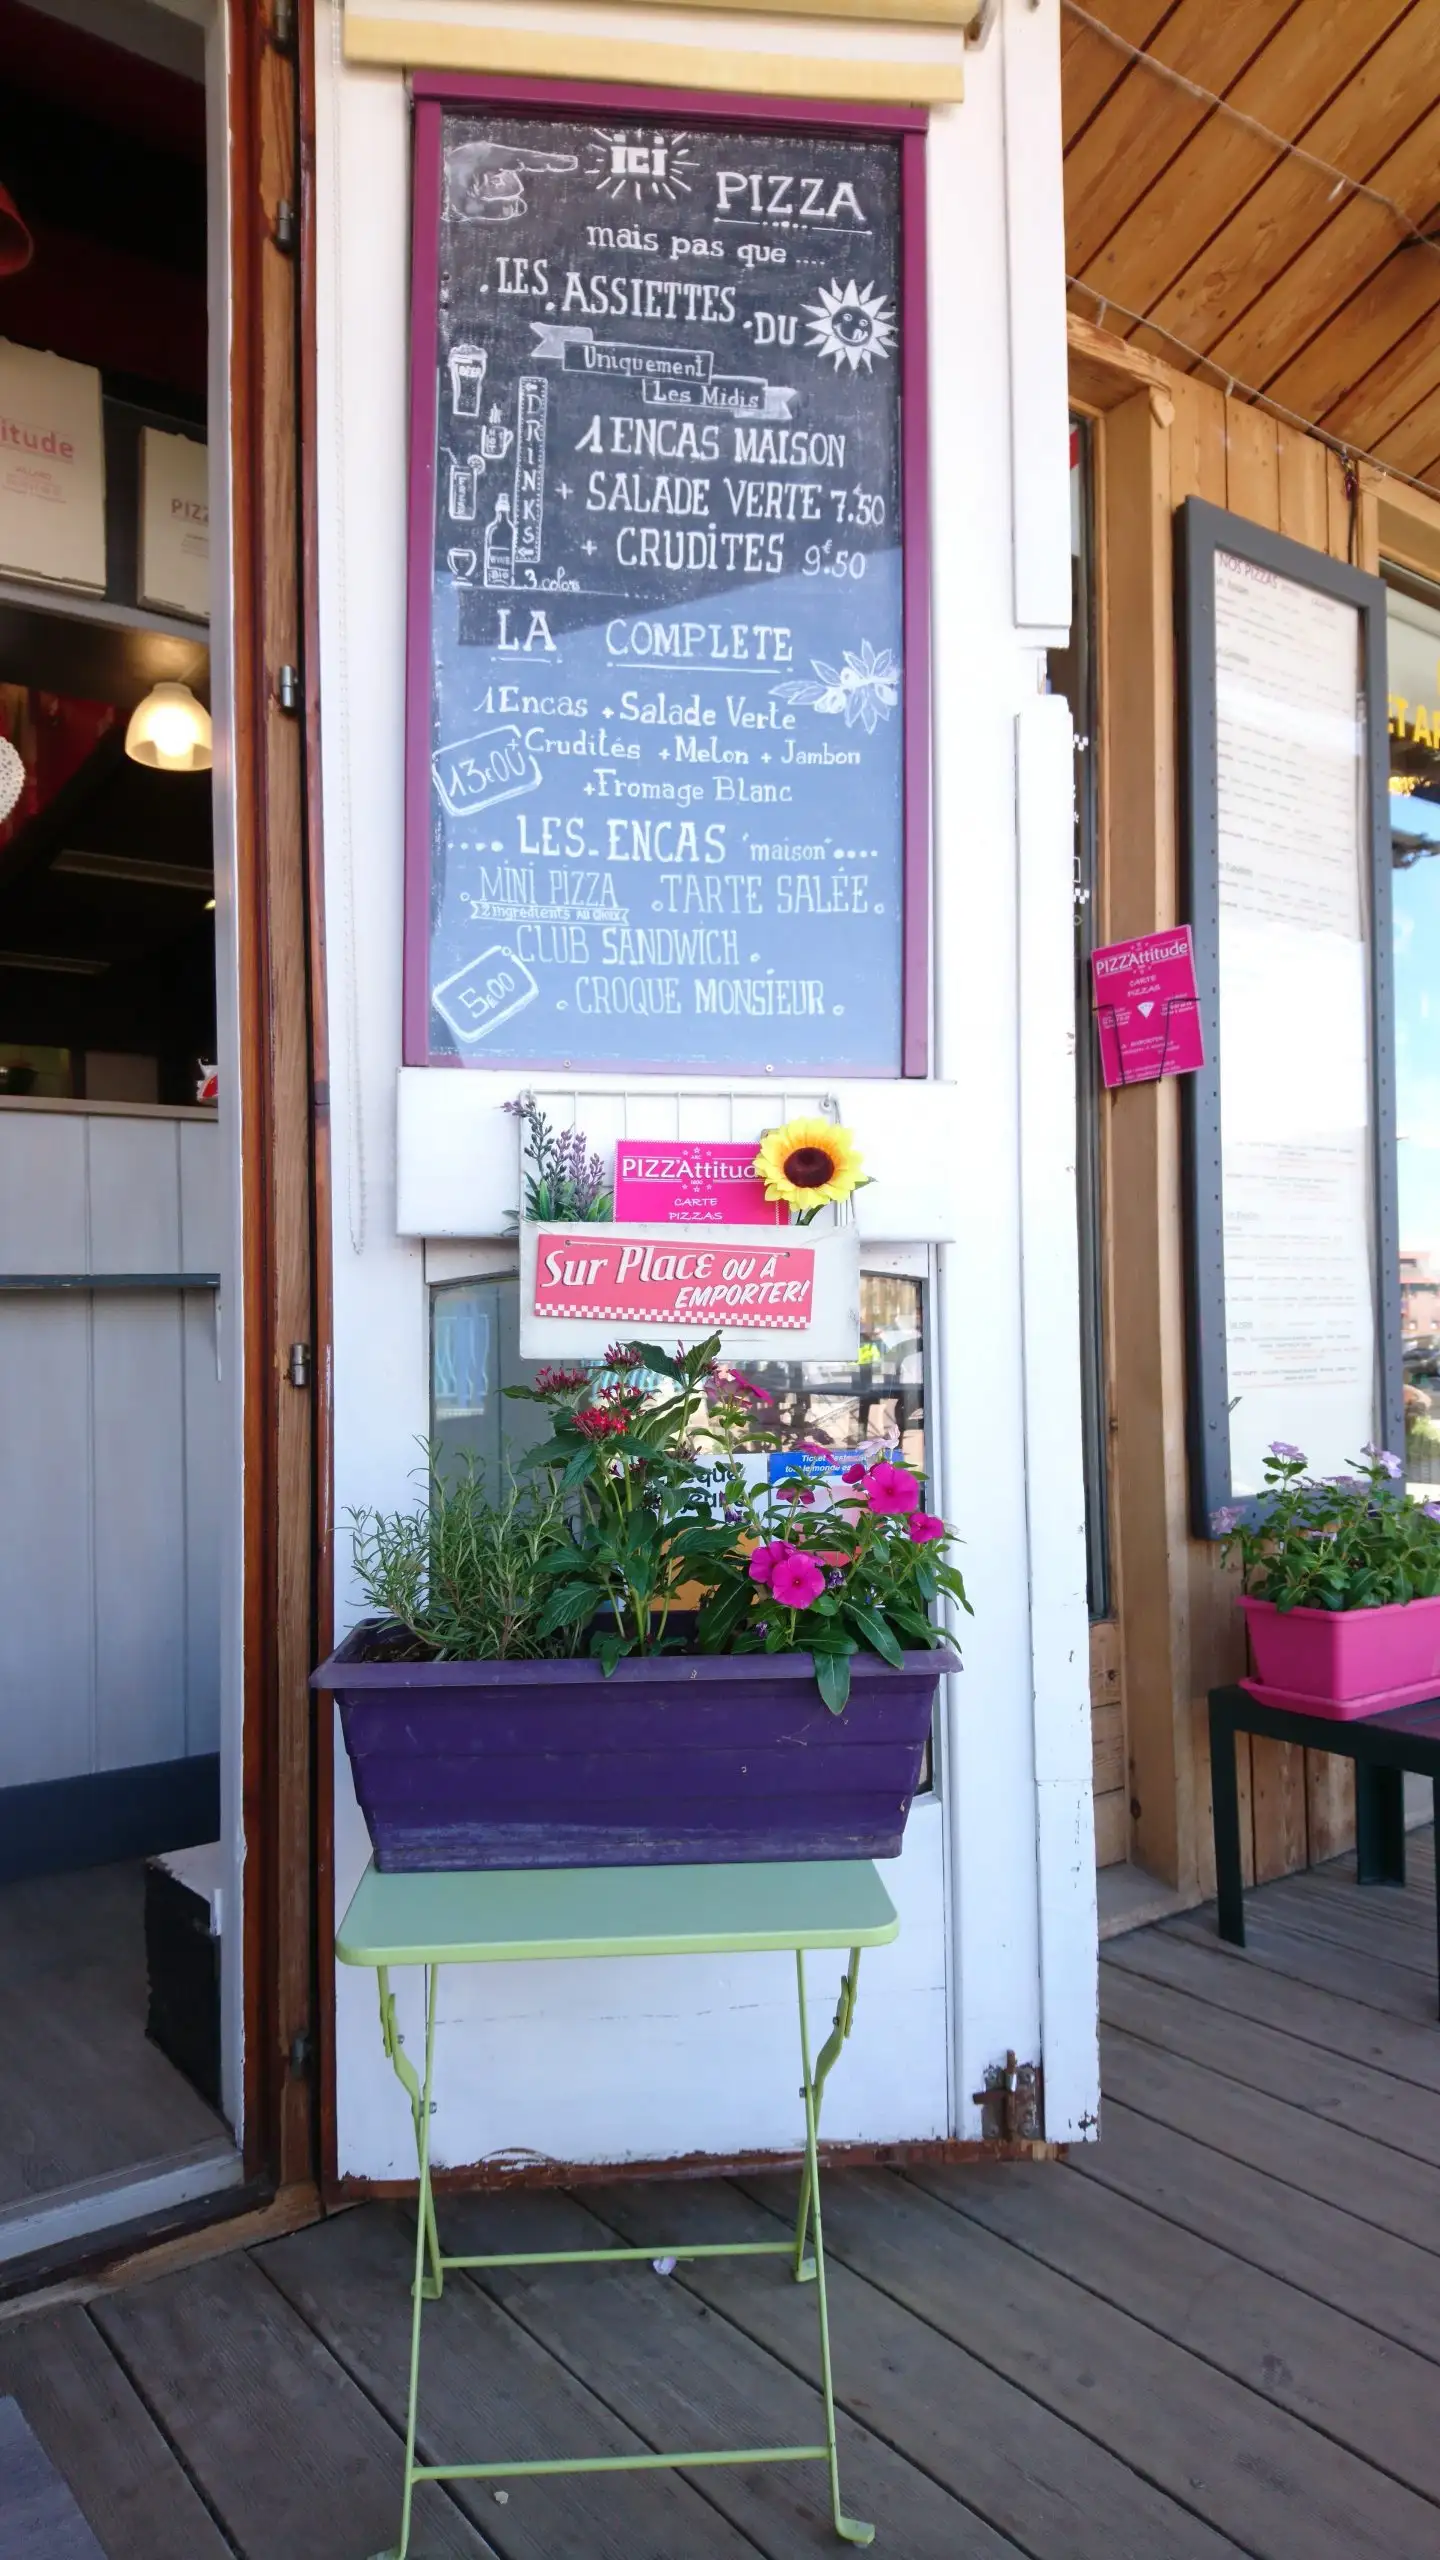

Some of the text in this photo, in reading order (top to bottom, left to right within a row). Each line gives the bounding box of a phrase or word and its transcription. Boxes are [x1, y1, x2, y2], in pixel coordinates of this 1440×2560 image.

[715, 171, 867, 221] PIZZA
[586, 225, 659, 253] mais
[669, 236, 724, 260] pas
[736, 242, 788, 268] que
[561, 271, 737, 323] ASSIETTES
[753, 311, 799, 346] DU
[583, 346, 707, 380] Uniquement
[653, 380, 760, 409] Les Midis
[611, 416, 720, 461] ENCAS
[734, 426, 846, 469] MAISON
[520, 394, 543, 544] DRINKS
[586, 471, 711, 517] SALADE
[724, 477, 822, 521] VERTE
[523, 568, 538, 588] 3
[497, 609, 793, 662] LA COMPLETE
[498, 686, 589, 718] Encas
[620, 690, 717, 727] Salade
[727, 695, 797, 731] Verte
[675, 735, 750, 765] Melon
[780, 741, 862, 766] Jambon
[594, 768, 704, 808] Fromage
[713, 776, 793, 803] Blanc
[516, 814, 584, 858] LES
[606, 818, 727, 864] ENCAS
[659, 873, 763, 915] TARTE
[515, 919, 740, 966] CLUB SANDWICH
[575, 976, 682, 1017] CROQUE
[668, 1210, 723, 1221] PIZZAS
[673, 1196, 718, 1208] CARTE
[540, 1249, 608, 1289] Sur
[615, 1245, 716, 1285] Place
[722, 1256, 756, 1282] OU
[674, 1278, 811, 1310] EMPORTER!
